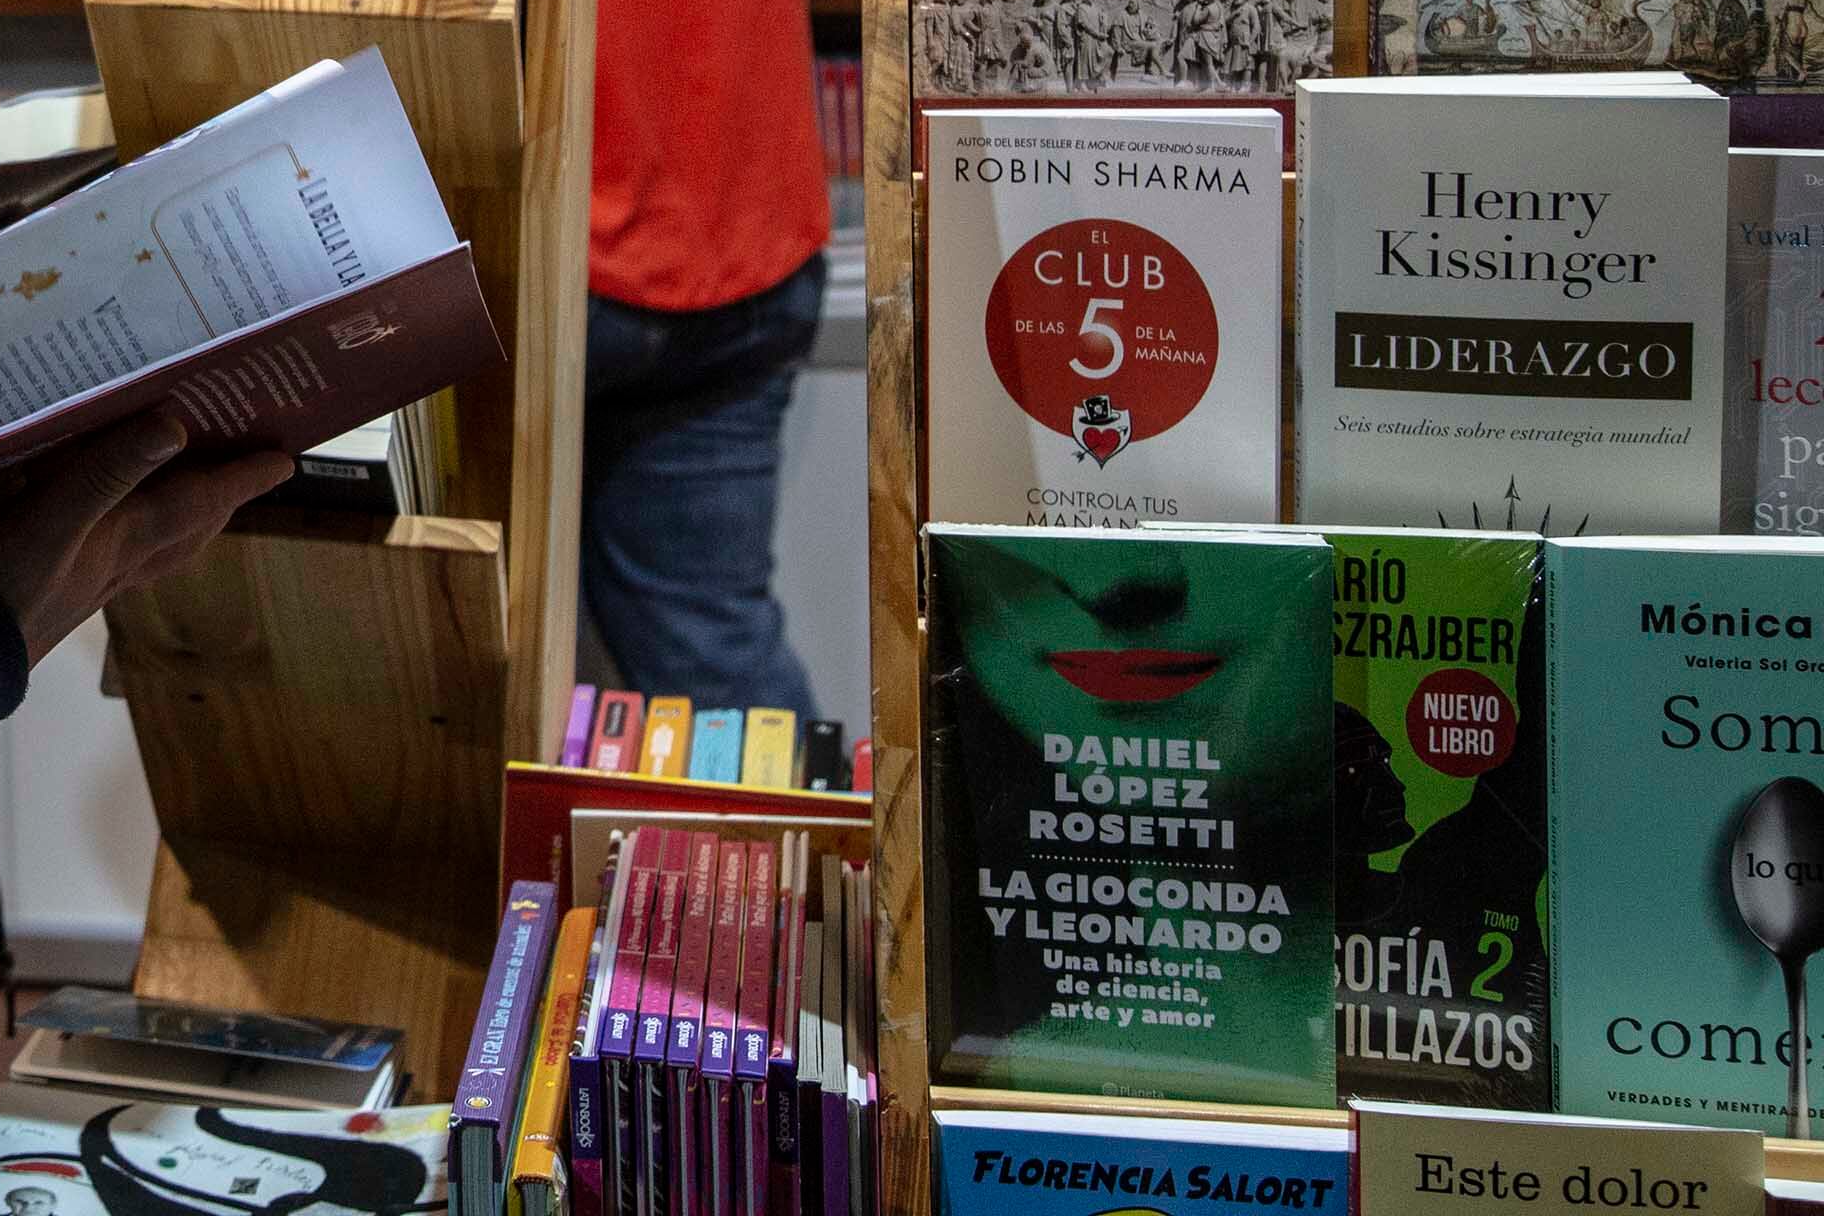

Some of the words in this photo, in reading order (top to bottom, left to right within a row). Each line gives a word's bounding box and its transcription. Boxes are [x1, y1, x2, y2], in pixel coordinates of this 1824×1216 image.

[956, 137, 992, 148] AUTOR
[994, 137, 1013, 148] DEL
[1014, 138, 1037, 148] BEST
[1040, 138, 1073, 149] SELLER
[1075, 139, 1088, 150] EL
[1088, 140, 1125, 151] MONJE
[1127, 141, 1151, 152] QUE
[1153, 142, 1194, 154] VENDIÓ
[1195, 145, 1210, 156] SU
[1211, 146, 1251, 158] FERRARI
[297, 177, 328, 209] LA
[955, 158, 1071, 185] ROBIN
[1094, 161, 1251, 195] SHARMA
[1420, 171, 1612, 239] Henry
[309, 203, 350, 256] BELLA
[1091, 230, 1110, 245] EL
[1740, 222, 1810, 247] Yuval
[332, 249, 358, 266] Y
[1034, 250, 1165, 290] CLUB
[1375, 229, 1656, 299] Kissinger
[1015, 319, 1034, 333] DE
[1039, 320, 1065, 334] LAS
[1069, 298, 1124, 380] 5
[1136, 326, 1153, 340] DE
[1159, 327, 1176, 341] LA
[1135, 346, 1206, 365] MAÑANA
[1349, 333, 1676, 379] LIDERAZGO
[1750, 357, 1824, 406] lec
[1334, 415, 1372, 433] Seis
[1376, 419, 1451, 437] estudios
[1454, 422, 1505, 440] sobre
[1510, 426, 1603, 447] estrategia
[1609, 427, 1691, 446] mundial
[1027, 488, 1136, 512] CONTROLA
[1143, 496, 1178, 516] TUS
[1641, 602, 1812, 639] Mónica
[1685, 655, 1752, 671] Valeria
[1759, 658, 1788, 672] Sol
[1424, 692, 1500, 723] NUEVO
[1661, 694, 1824, 754] Som
[1043, 734, 1221, 770] DANIEL
[1429, 726, 1495, 756] LIBRO
[1055, 766, 1209, 809] LÓPEZ
[1029, 810, 1234, 849] ROSETTI
[1746, 853, 1775, 878] lo
[979, 868, 1036, 900] LA
[1045, 872, 1290, 915] GIOCONDA
[985, 907, 1016, 937] Y
[1026, 910, 1282, 954] LEONARDO
[1483, 910, 1519, 931] TOMO
[1043, 949, 1100, 973] Una
[1106, 953, 1223, 981] historia
[1470, 931, 1513, 1002] 2
[1056, 975, 1090, 996] de
[1097, 977, 1209, 1007] ciencia,
[1050, 1000, 1109, 1021] arte
[1117, 1007, 1135, 1028] y
[1141, 1007, 1216, 1029] amor
[1607, 1017, 1824, 1067] come
[1120, 1085, 1165, 1099] Planeta
[1607, 1091, 1692, 1109] VERDADES
[1700, 1099, 1709, 1110] Y
[1716, 1100, 1798, 1117] MENTIRAS
[577, 1087, 594, 1148] LATINBOOKS
[972, 1151, 1177, 1196] FLORENCIA
[1186, 1165, 1335, 1209] SALORT
[1415, 1153, 1541, 1202] Este
[1563, 1166, 1708, 1210] dolor
